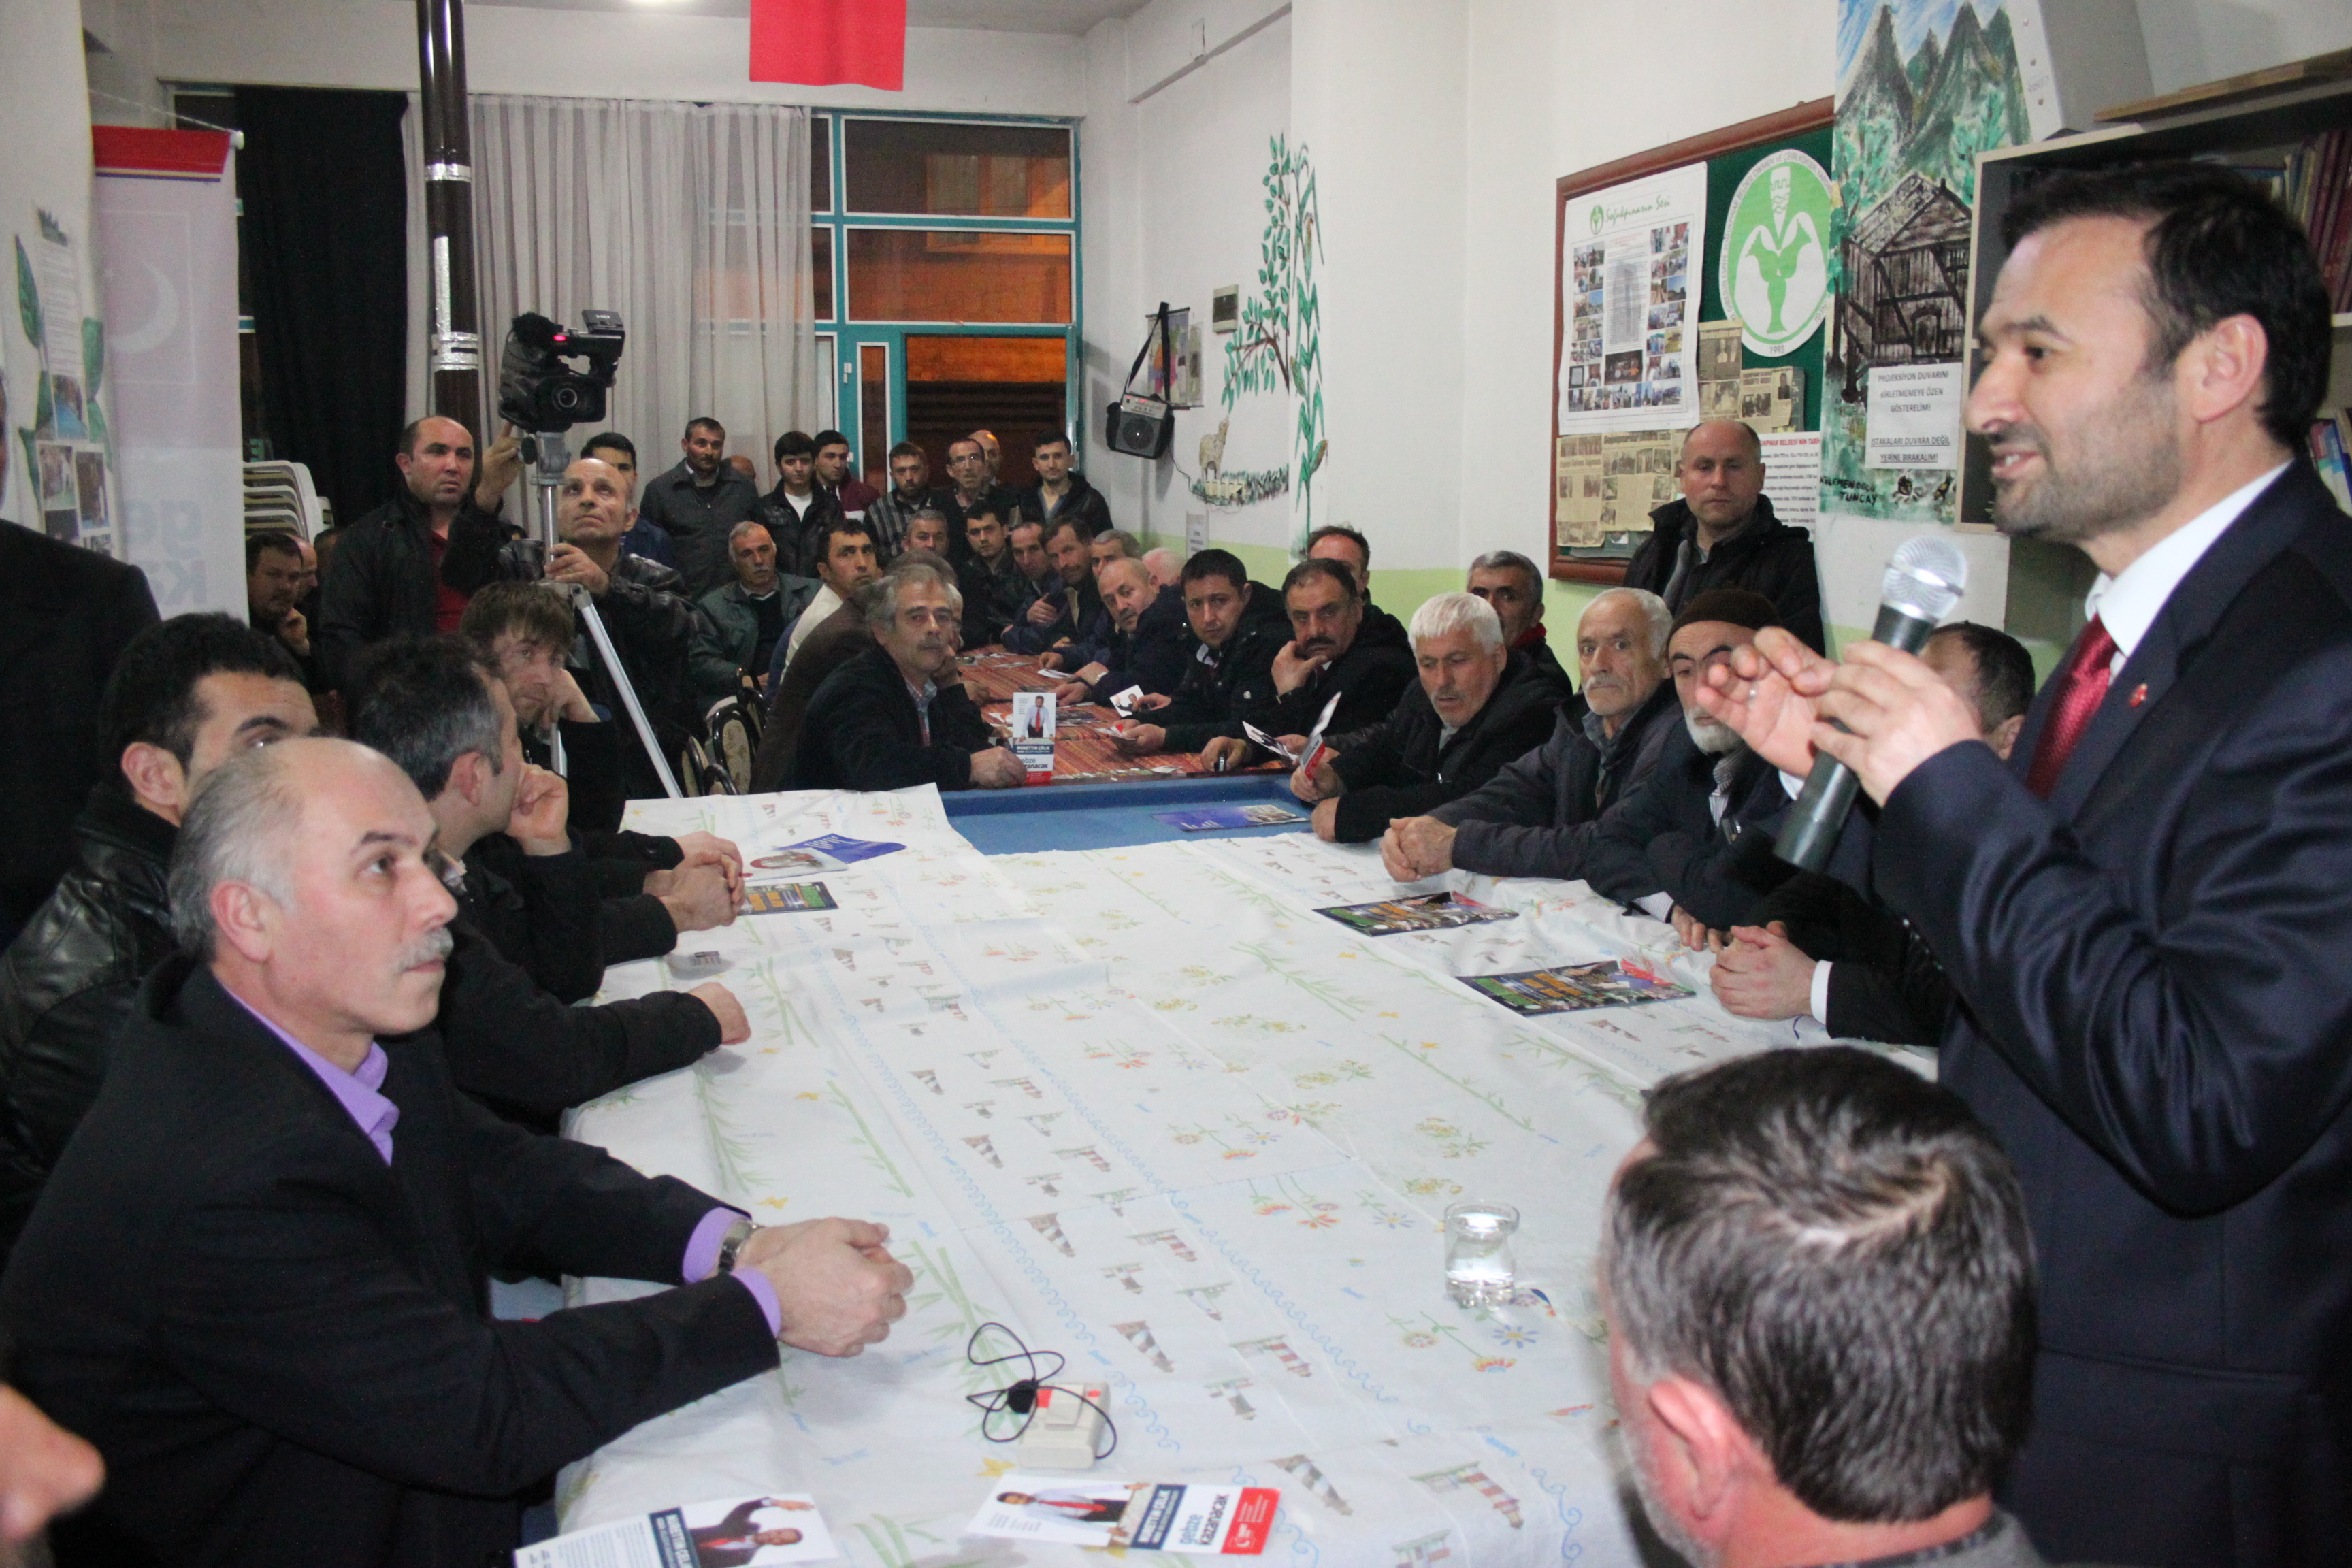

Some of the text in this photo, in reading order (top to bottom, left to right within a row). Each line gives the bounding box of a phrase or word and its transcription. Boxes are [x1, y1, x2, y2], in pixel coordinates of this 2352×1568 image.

[1770, 345, 1784, 354] 1993
[1918, 370, 1949, 380] DUVARINI
[1926, 387, 1944, 396] ÖZEN
[1891, 402, 1931, 413] GÖSTERELİM!
[1905, 436, 1930, 445] DUVARA
[1931, 435, 1950, 445] DEĞİL
[1880, 453, 1938, 461] YERİNE BIRAKALIM!
